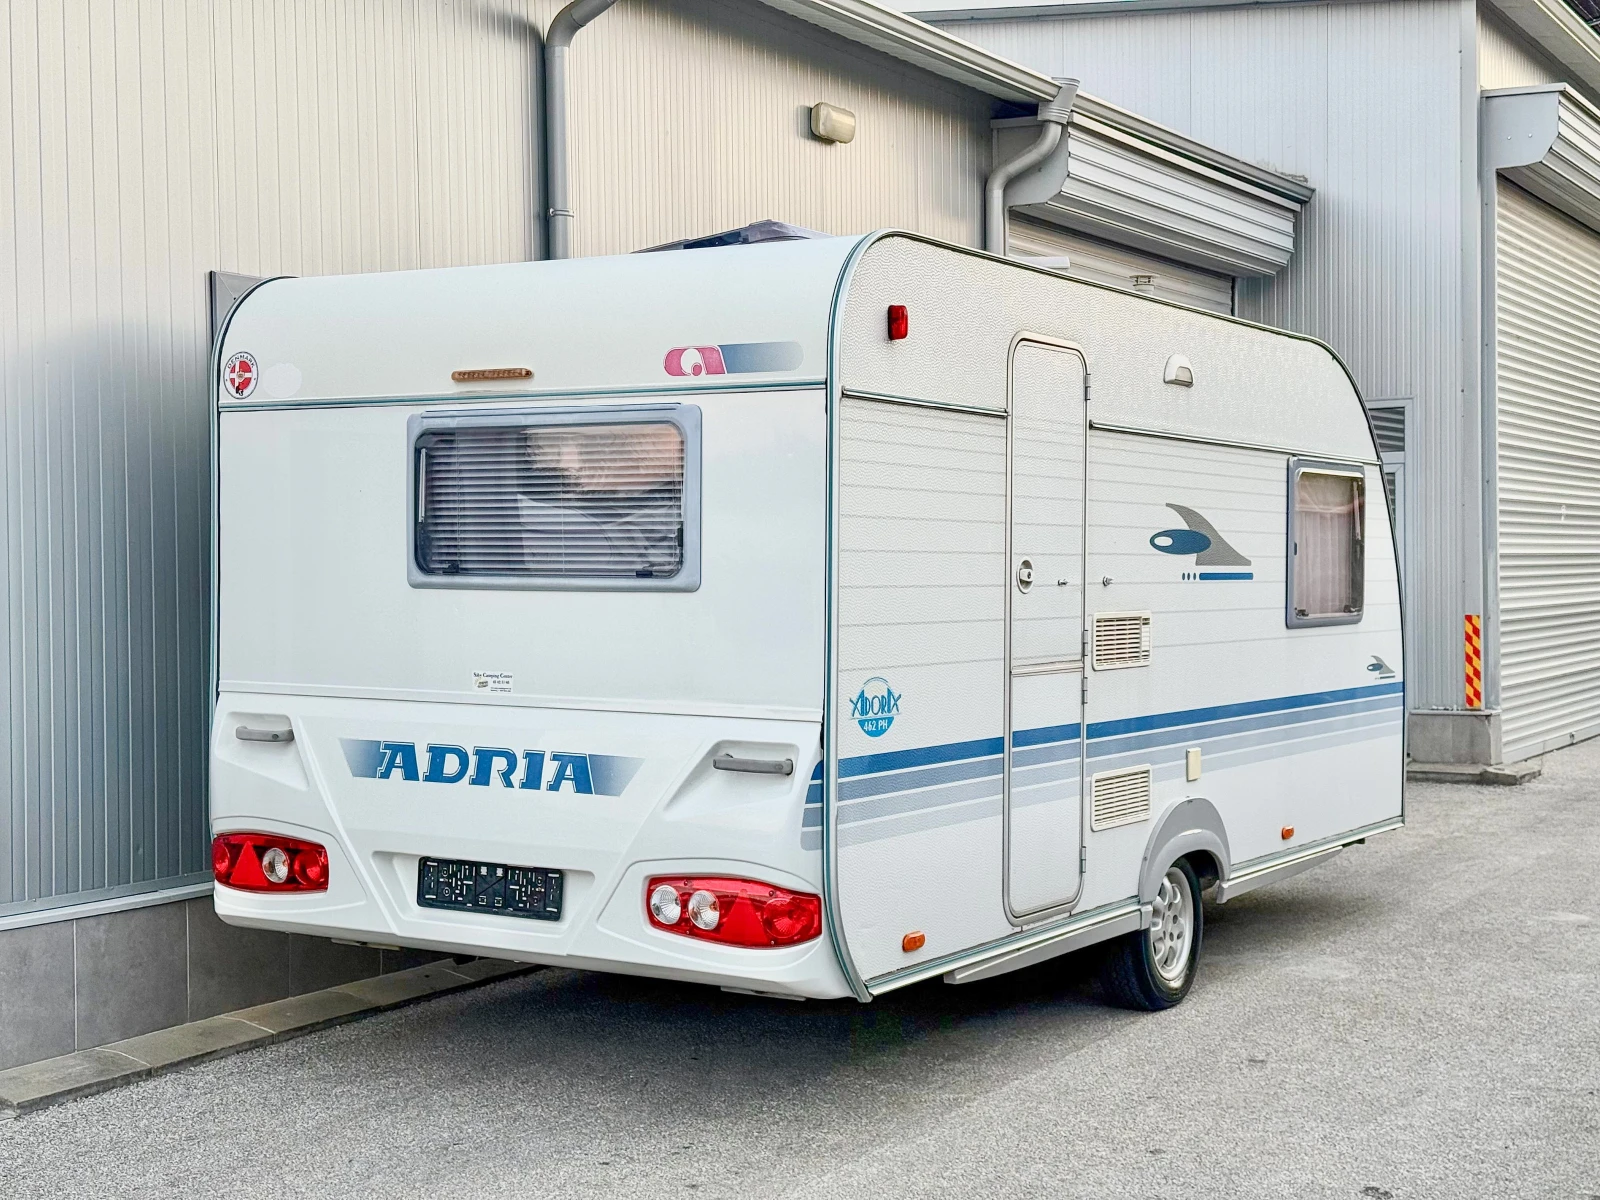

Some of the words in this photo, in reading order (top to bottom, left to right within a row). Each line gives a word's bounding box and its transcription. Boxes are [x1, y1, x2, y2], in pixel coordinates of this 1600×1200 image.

[227, 354, 255, 369] DENMARK
[878, 719, 888, 731] PH
[377, 740, 594, 795] ADRIA
